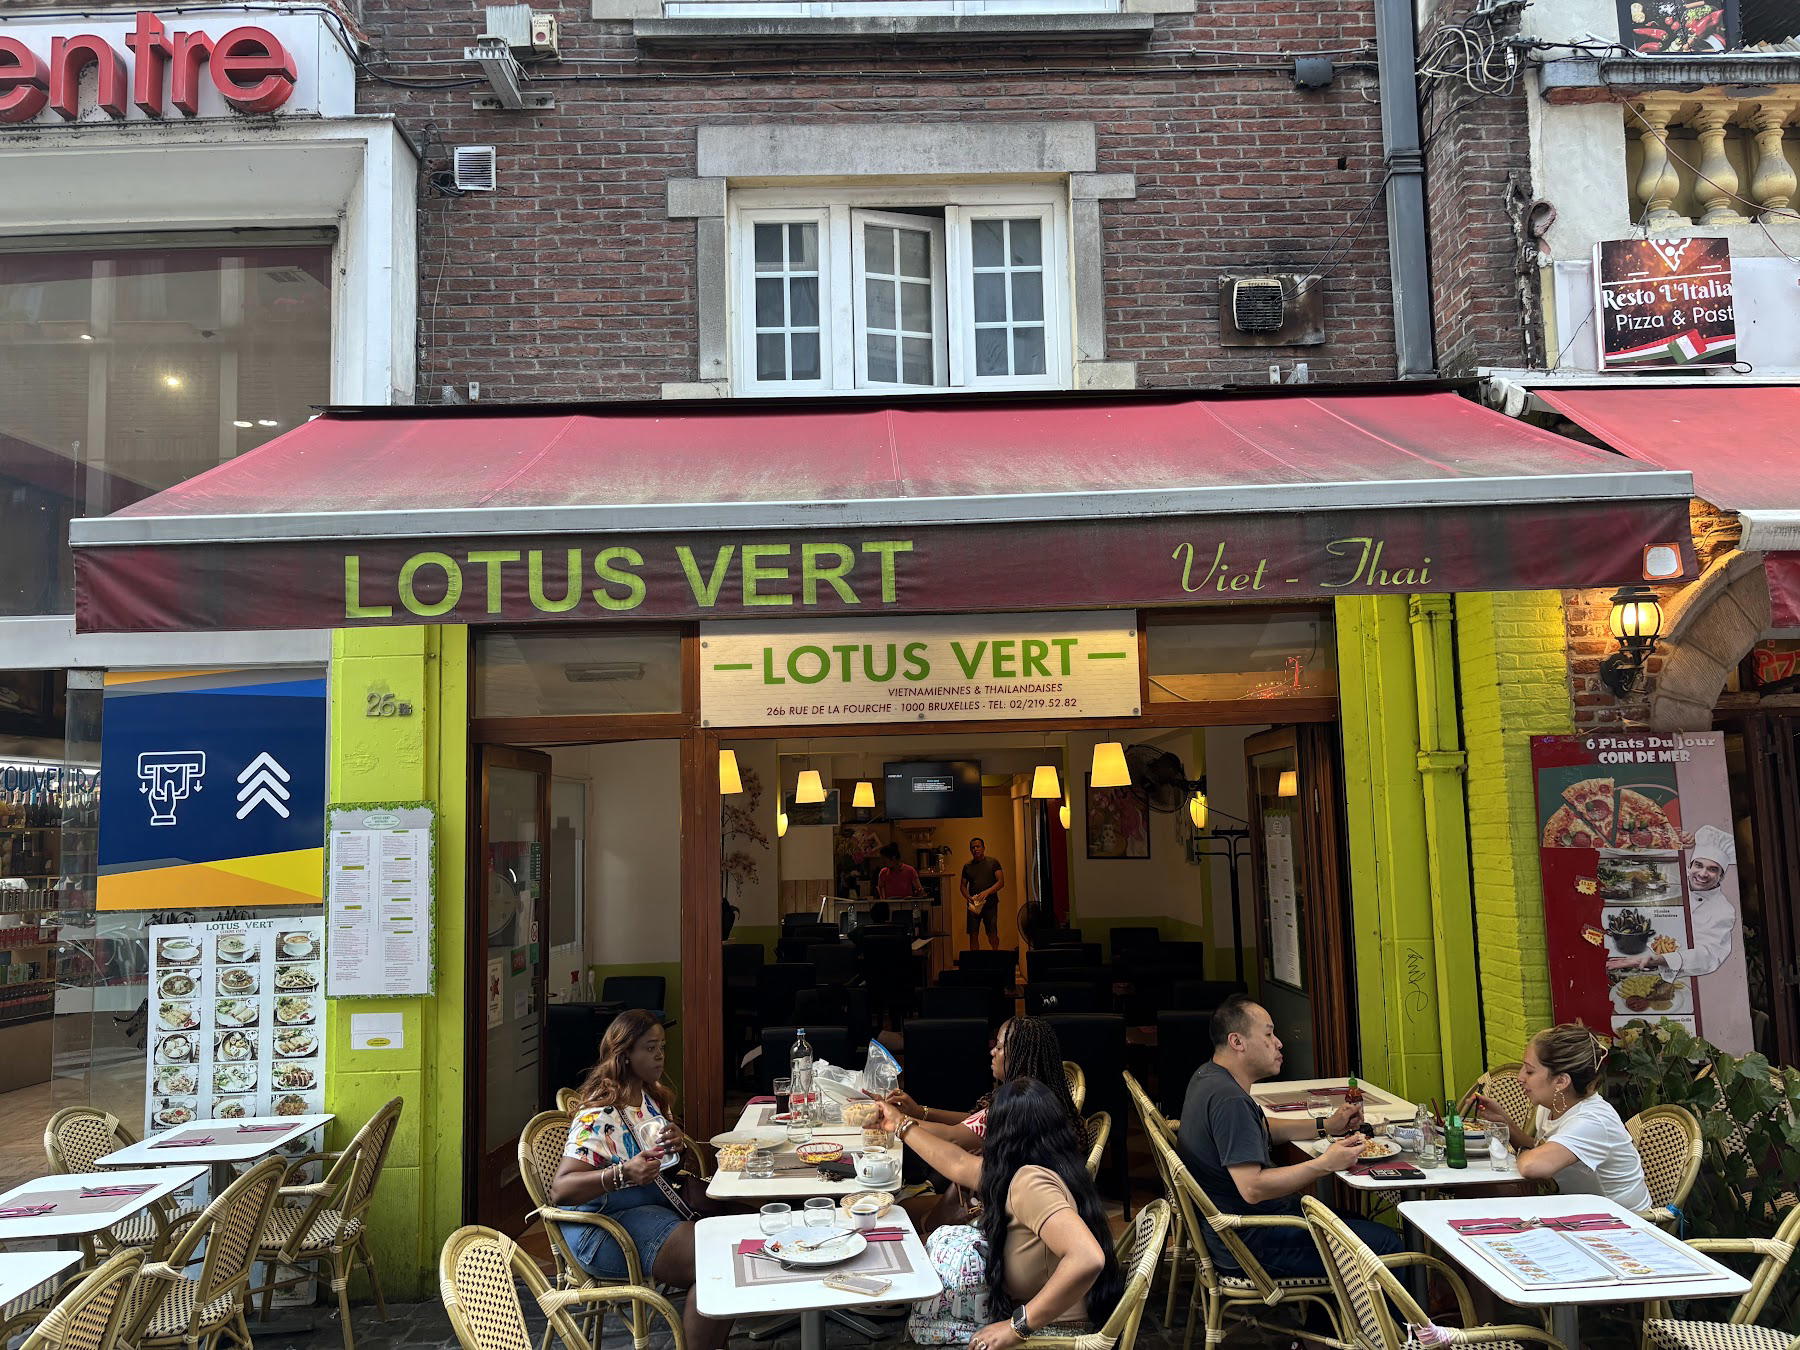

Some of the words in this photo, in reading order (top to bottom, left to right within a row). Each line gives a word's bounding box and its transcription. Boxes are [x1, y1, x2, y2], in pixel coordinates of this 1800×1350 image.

[1602, 288, 1655, 311] Resto
[1615, 314, 1665, 332] Pizza
[1672, 309, 1686, 326] &
[1172, 541, 1269, 592] Viet
[1319, 537, 1433, 588] Thai
[344, 545, 645, 619] LOTUS
[675, 540, 914, 608] VERT
[763, 642, 930, 685] LOTUS
[950, 638, 1078, 680] VERT
[888, 685, 971, 697] VIETNAMIENNES
[975, 685, 982, 695] &
[985, 683, 1063, 695] THAILANDAISES
[766, 706, 786, 716] 26b
[789, 705, 809, 715] RUE
[812, 705, 825, 715] DE
[828, 704, 840, 714] LA
[843, 703, 892, 714] FOURCHE
[901, 702, 925, 712] 1000
[928, 700, 980, 711] BRUXELLES
[989, 699, 1006, 710] TEL:
[1009, 698, 1077, 710] 02/219.52.82
[1586, 738, 1596, 750] 6
[1598, 736, 1645, 749] Plats
[1648, 736, 1674, 748] Du
[1598, 751, 1634, 764] COIN
[1636, 751, 1656, 764] DE
[1658, 750, 1691, 763] MER
[206, 922, 239, 931] LOTUS
[245, 920, 274, 929] VERT
